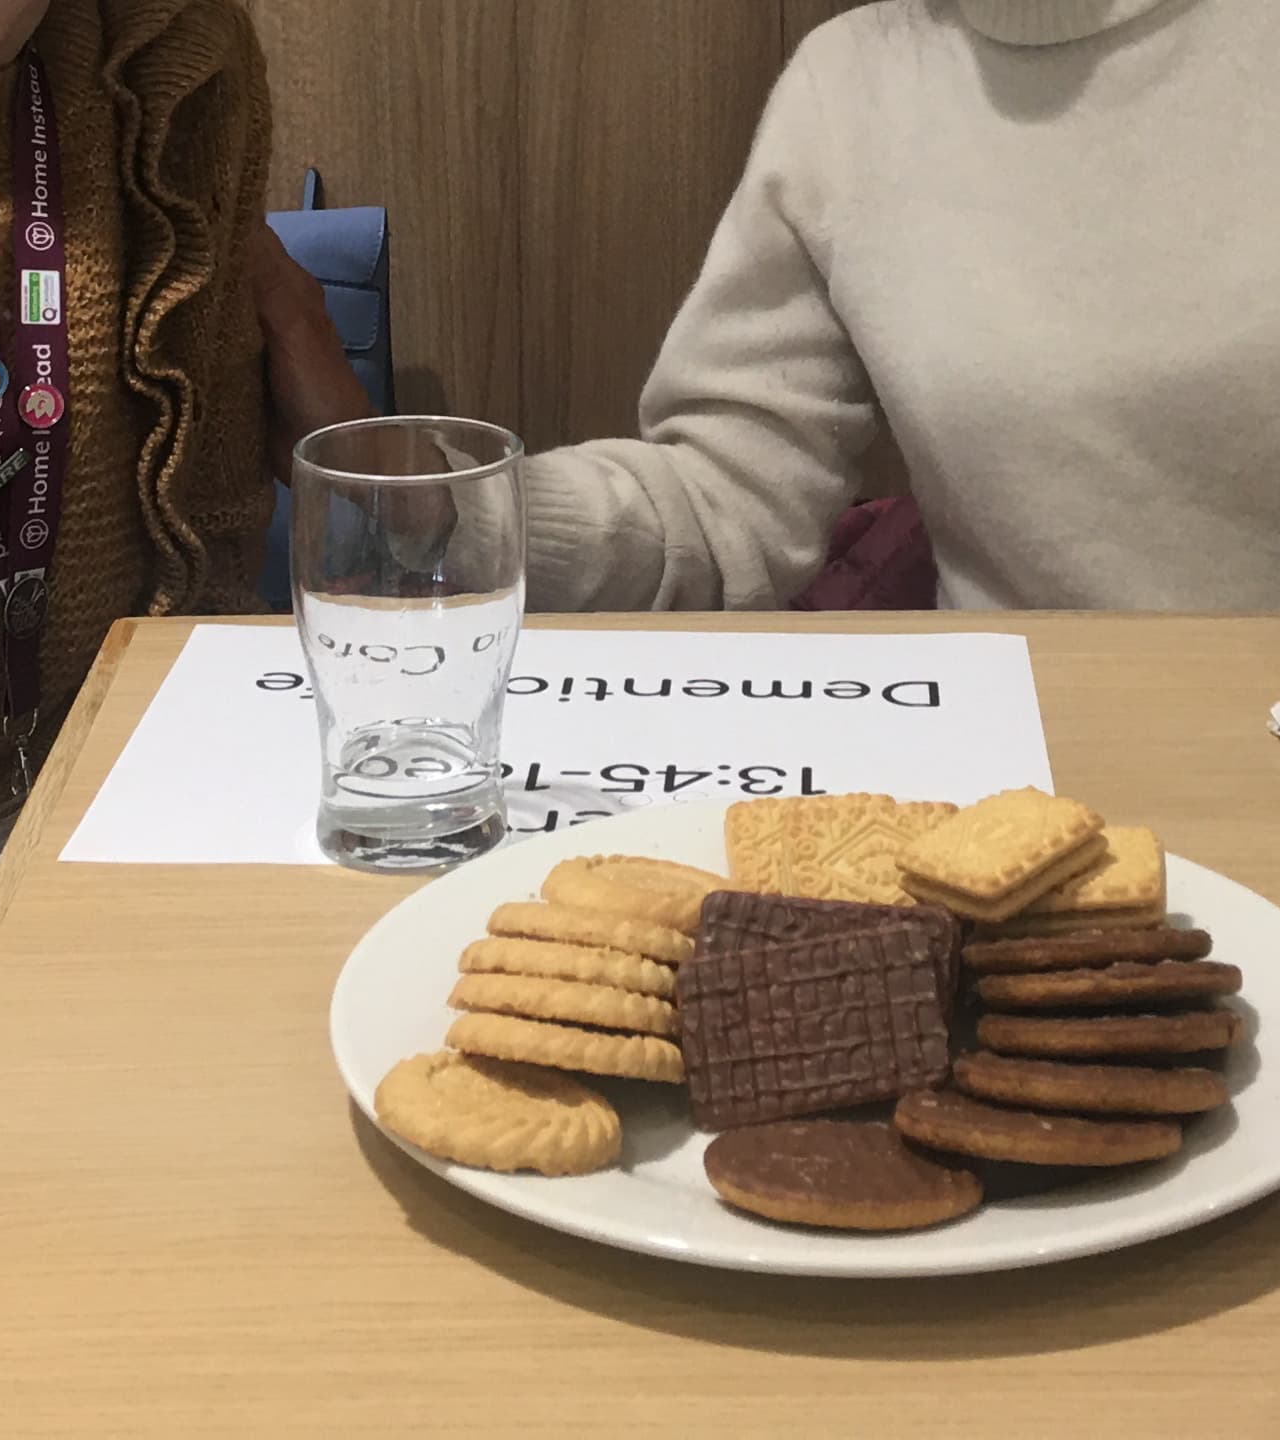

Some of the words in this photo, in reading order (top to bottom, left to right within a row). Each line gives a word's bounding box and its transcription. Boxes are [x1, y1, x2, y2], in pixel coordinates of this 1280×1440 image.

[30, 63, 48, 146] Instead
[31, 150, 48, 218] Home
[28, 441, 51, 514] Home
[501, 762, 827, 796] 13:45-1
